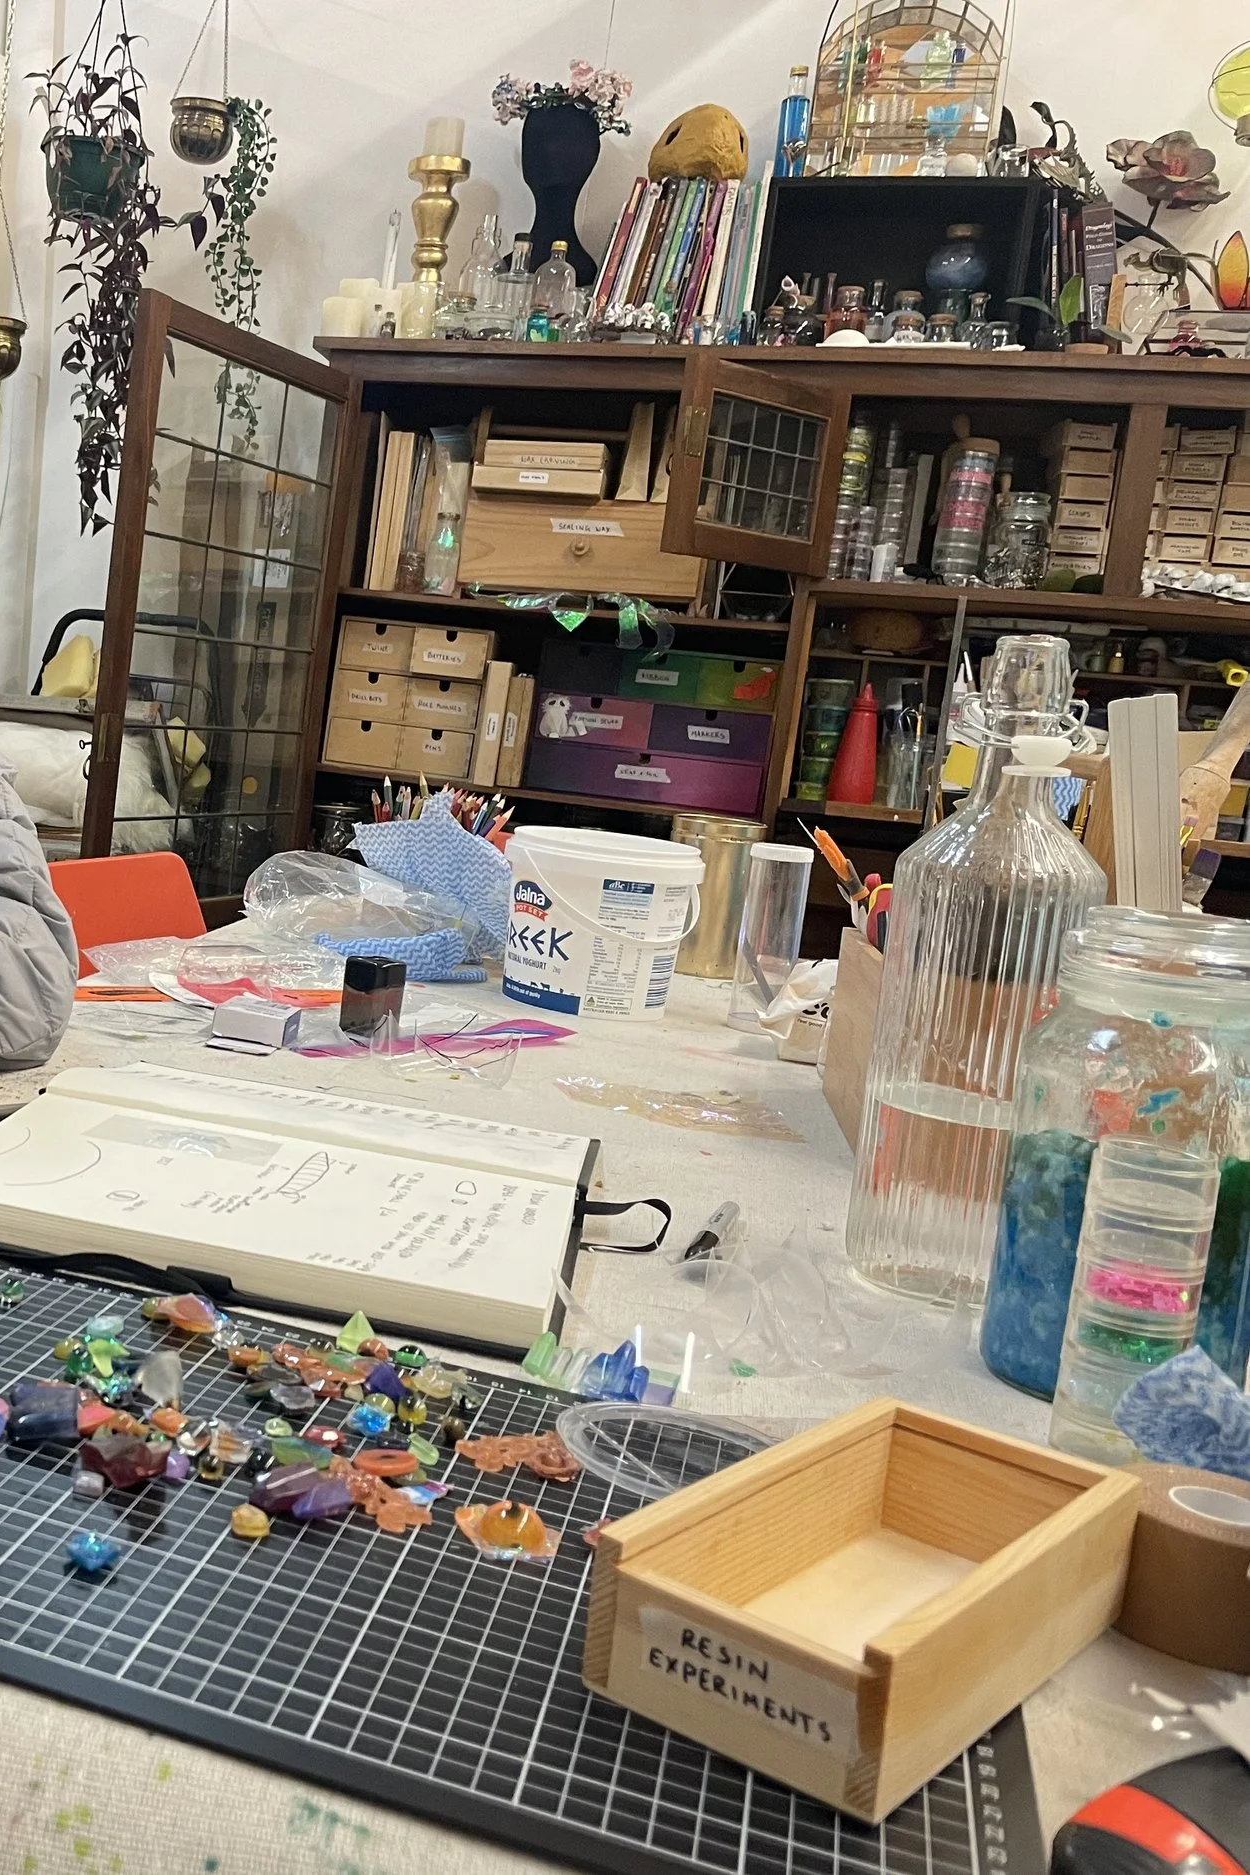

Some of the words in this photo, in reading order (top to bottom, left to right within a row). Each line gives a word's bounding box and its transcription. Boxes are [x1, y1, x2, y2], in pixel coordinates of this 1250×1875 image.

[558, 522, 591, 532] SEALING
[366, 643, 390, 653] TWINE
[426, 651, 463, 664] BATTERIES
[368, 694, 383, 703] BITS
[690, 730, 727, 740] MARKERS
[424, 744, 442, 752] PINS
[515, 884, 546, 907] Jalna
[516, 904, 527, 912] POT
[528, 906, 544, 918] SET
[507, 920, 574, 961] REEK
[522, 956, 548, 971] YOGHURT
[681, 1628, 770, 1684] RESIN
[648, 1646, 832, 1743] EXPERIMENTS
